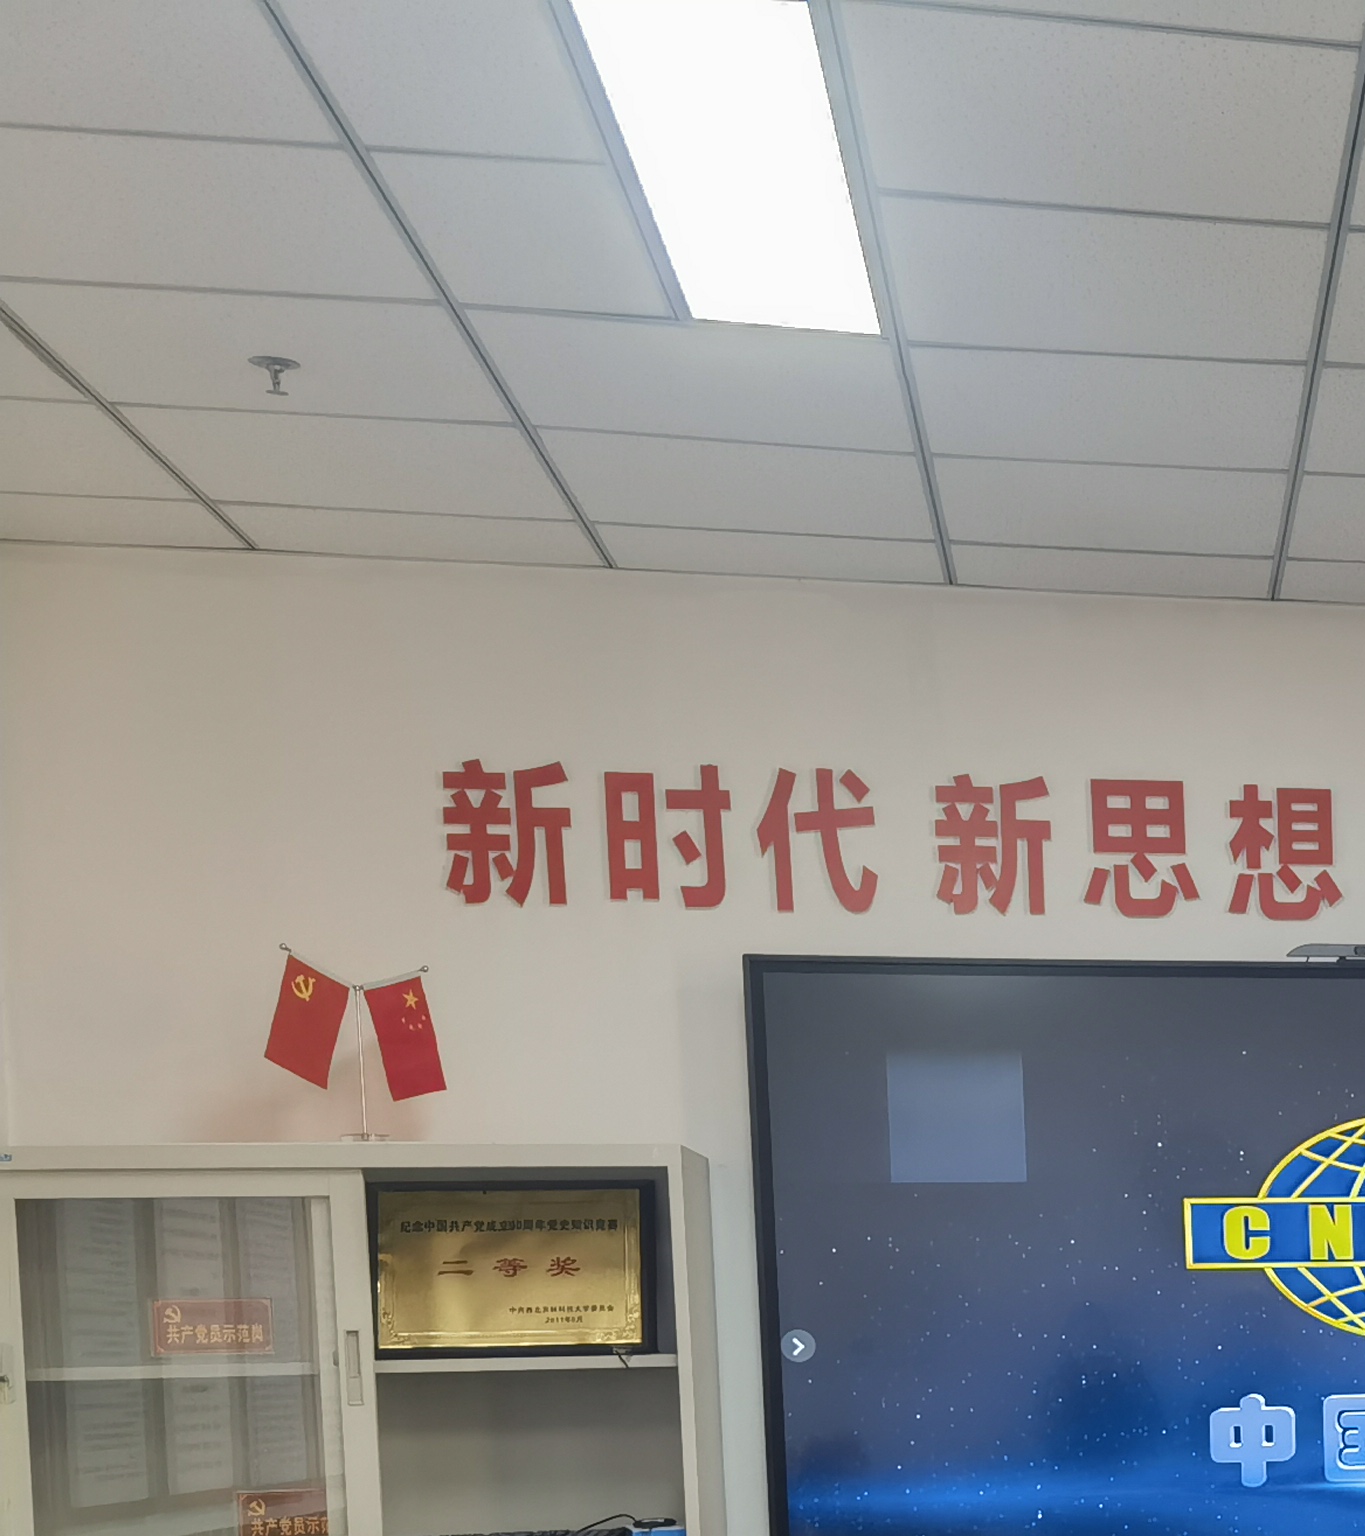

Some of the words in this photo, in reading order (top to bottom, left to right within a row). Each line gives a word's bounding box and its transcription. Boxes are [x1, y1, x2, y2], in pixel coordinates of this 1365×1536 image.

[441, 759, 879, 915] 新时代
[934, 772, 1343, 921] 新思想
[437, 1256, 581, 1278] 二等奖
[166, 1324, 264, 1345] 共产党员示范岗
